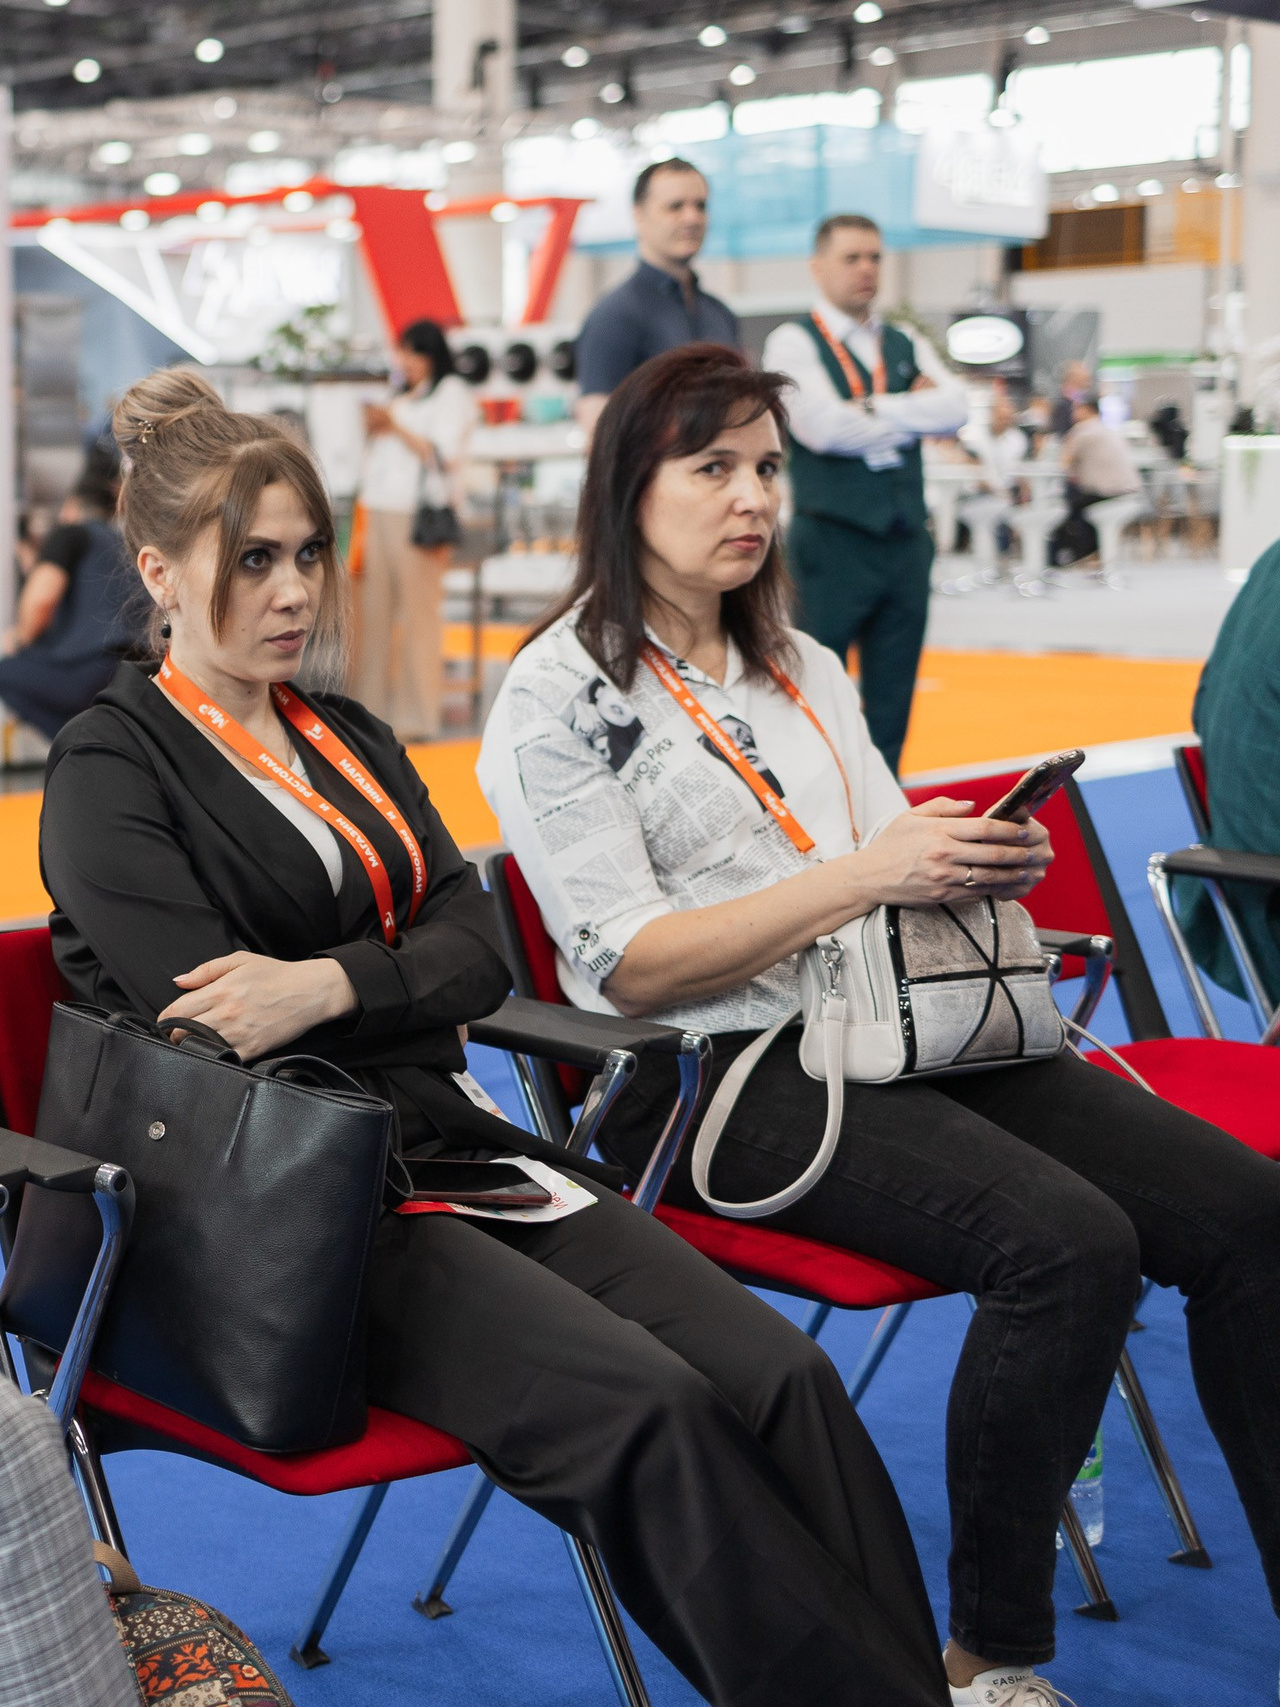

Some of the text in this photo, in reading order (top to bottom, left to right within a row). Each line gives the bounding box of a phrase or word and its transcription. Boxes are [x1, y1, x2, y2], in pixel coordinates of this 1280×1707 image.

[258, 752, 314, 799] РЕСТОРАН
[319, 803, 330, 812] И
[339, 758, 384, 804] МАГАЗИН
[386, 811, 397, 820] И
[399, 829, 423, 894] РЕСТОРАН
[335, 817, 379, 869] МАГАЗИН
